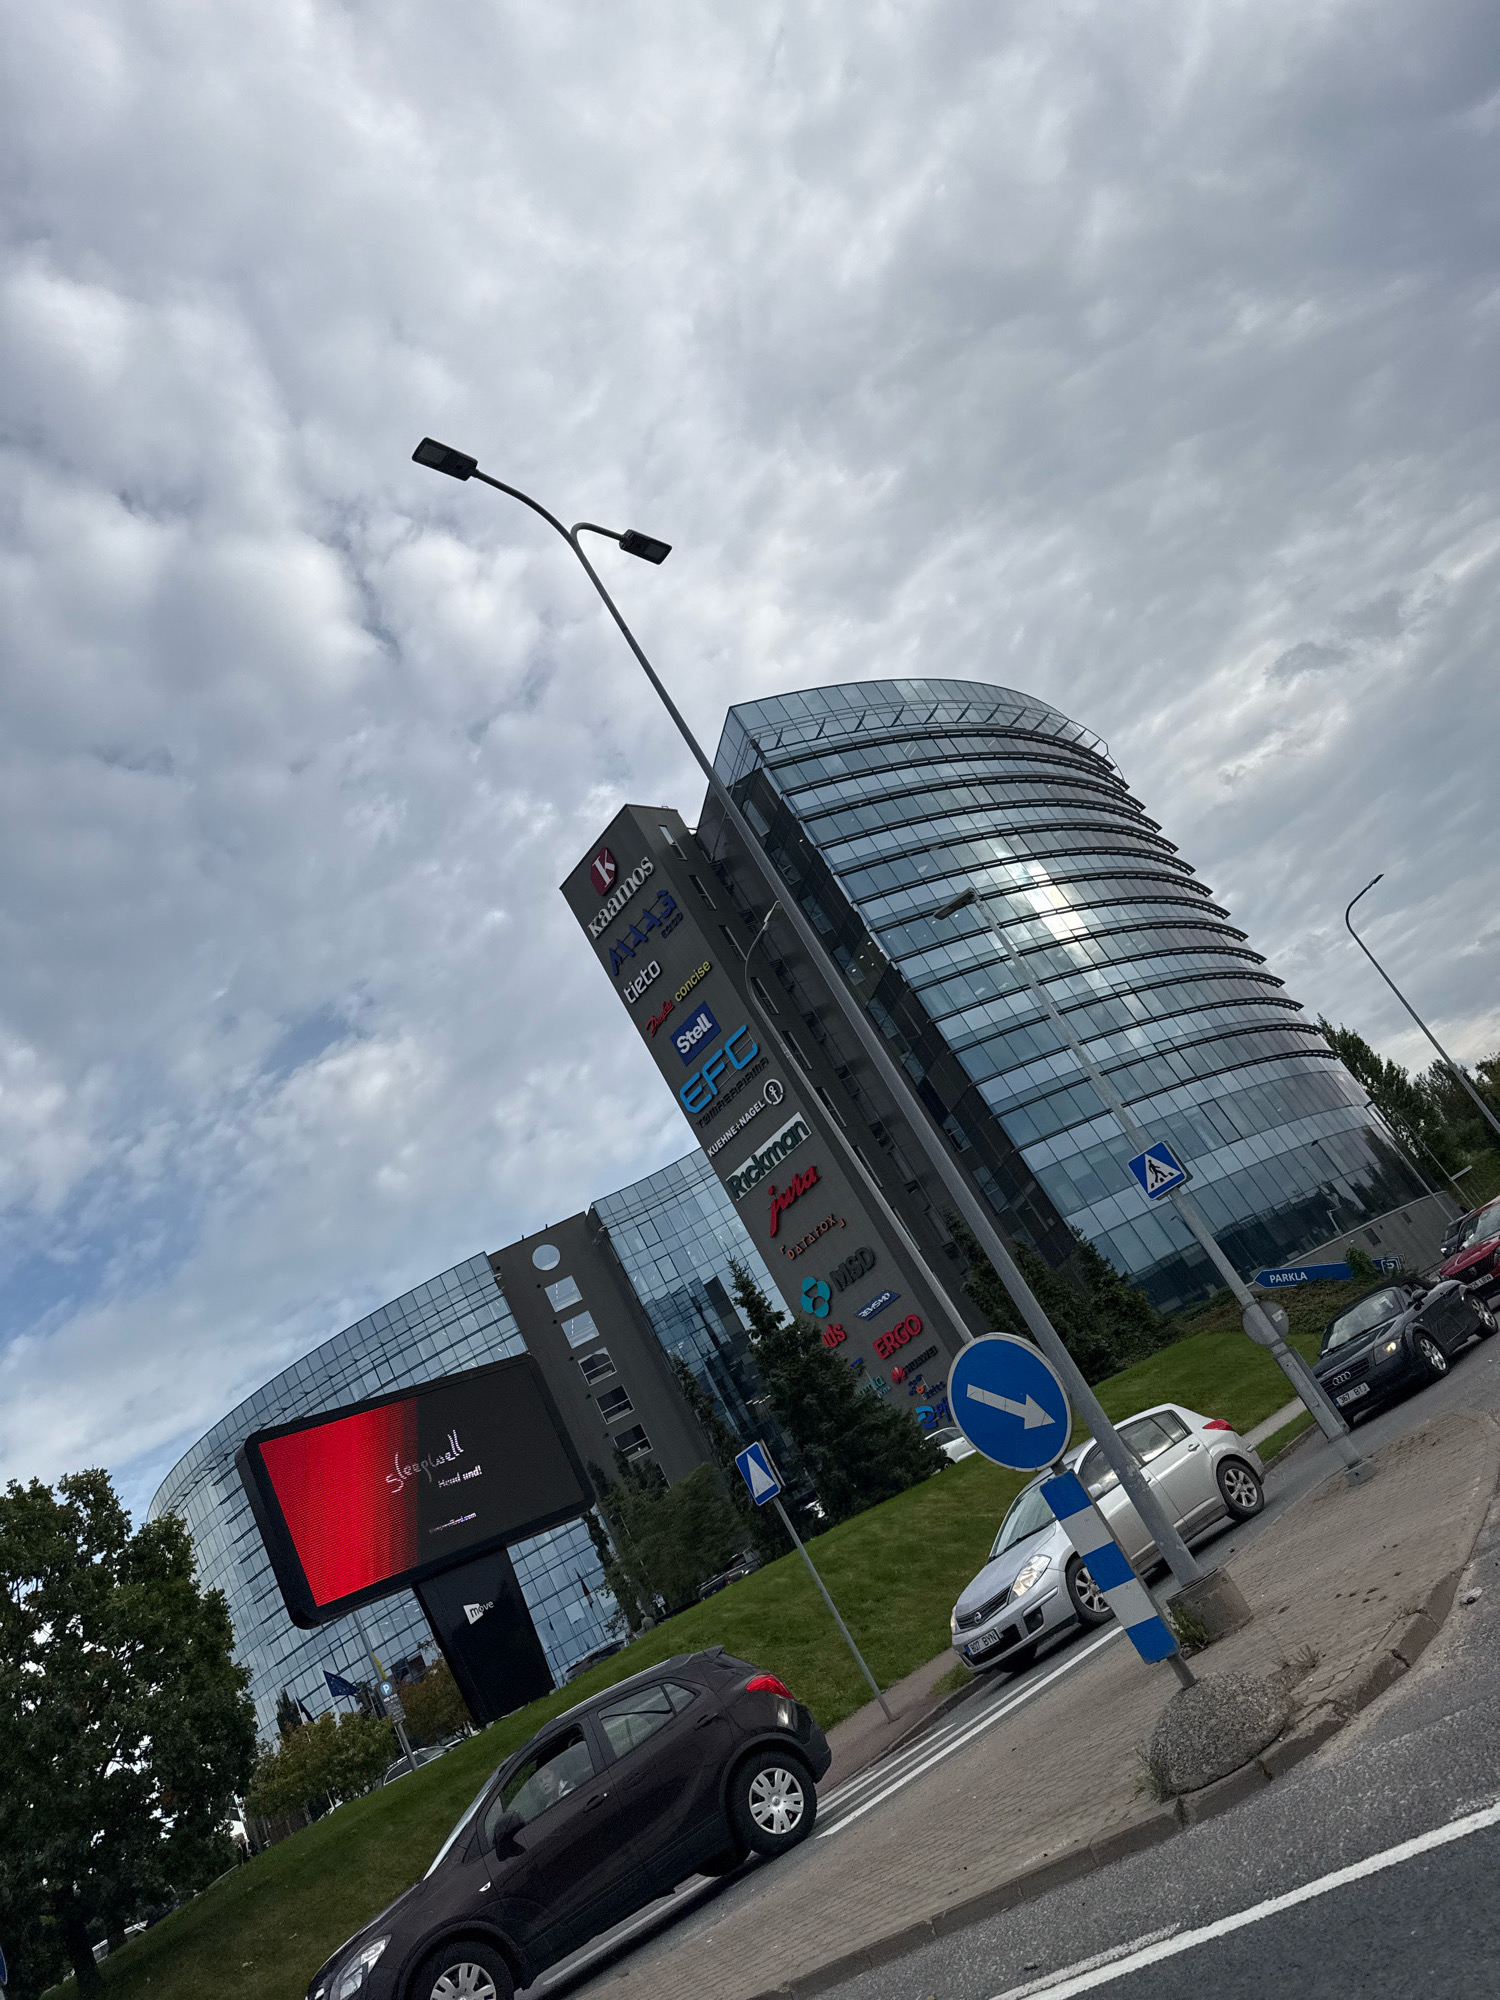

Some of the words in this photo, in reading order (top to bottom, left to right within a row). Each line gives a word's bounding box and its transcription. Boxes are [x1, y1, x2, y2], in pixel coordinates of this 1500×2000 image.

[624, 960, 661, 1003] tieto
[674, 961, 712, 1002] concise
[676, 1013, 713, 1054] Stell
[679, 1024, 759, 1114] EFC
[707, 1100, 766, 1157] KUEHNE+NAGEL
[786, 1214, 837, 1260] DATAFOX
[828, 1247, 876, 1292] MSD
[1269, 1272, 1308, 1284] PARKLA
[872, 1314, 924, 1360] ERGO
[905, 1345, 938, 1375] HUAWEI
[469, 1599, 495, 1618] move
[981, 1632, 998, 1646] BYN
